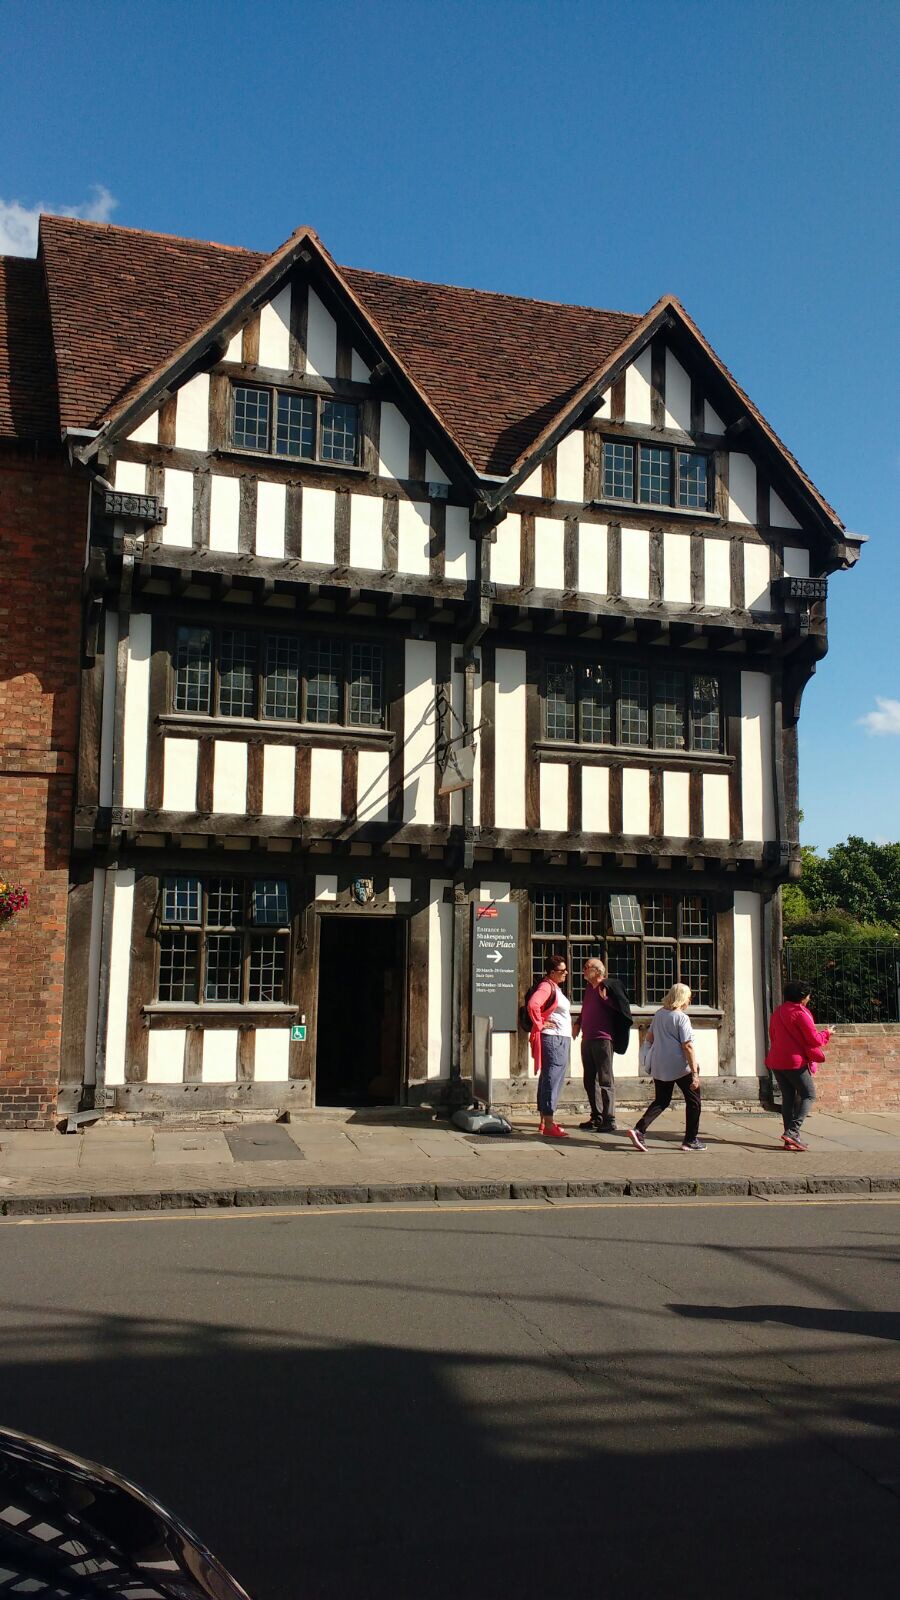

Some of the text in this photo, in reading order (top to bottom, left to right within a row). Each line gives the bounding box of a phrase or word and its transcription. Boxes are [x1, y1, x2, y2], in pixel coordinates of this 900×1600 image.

[476, 933, 514, 941] Shakespeare's
[478, 940, 516, 948] New Place
